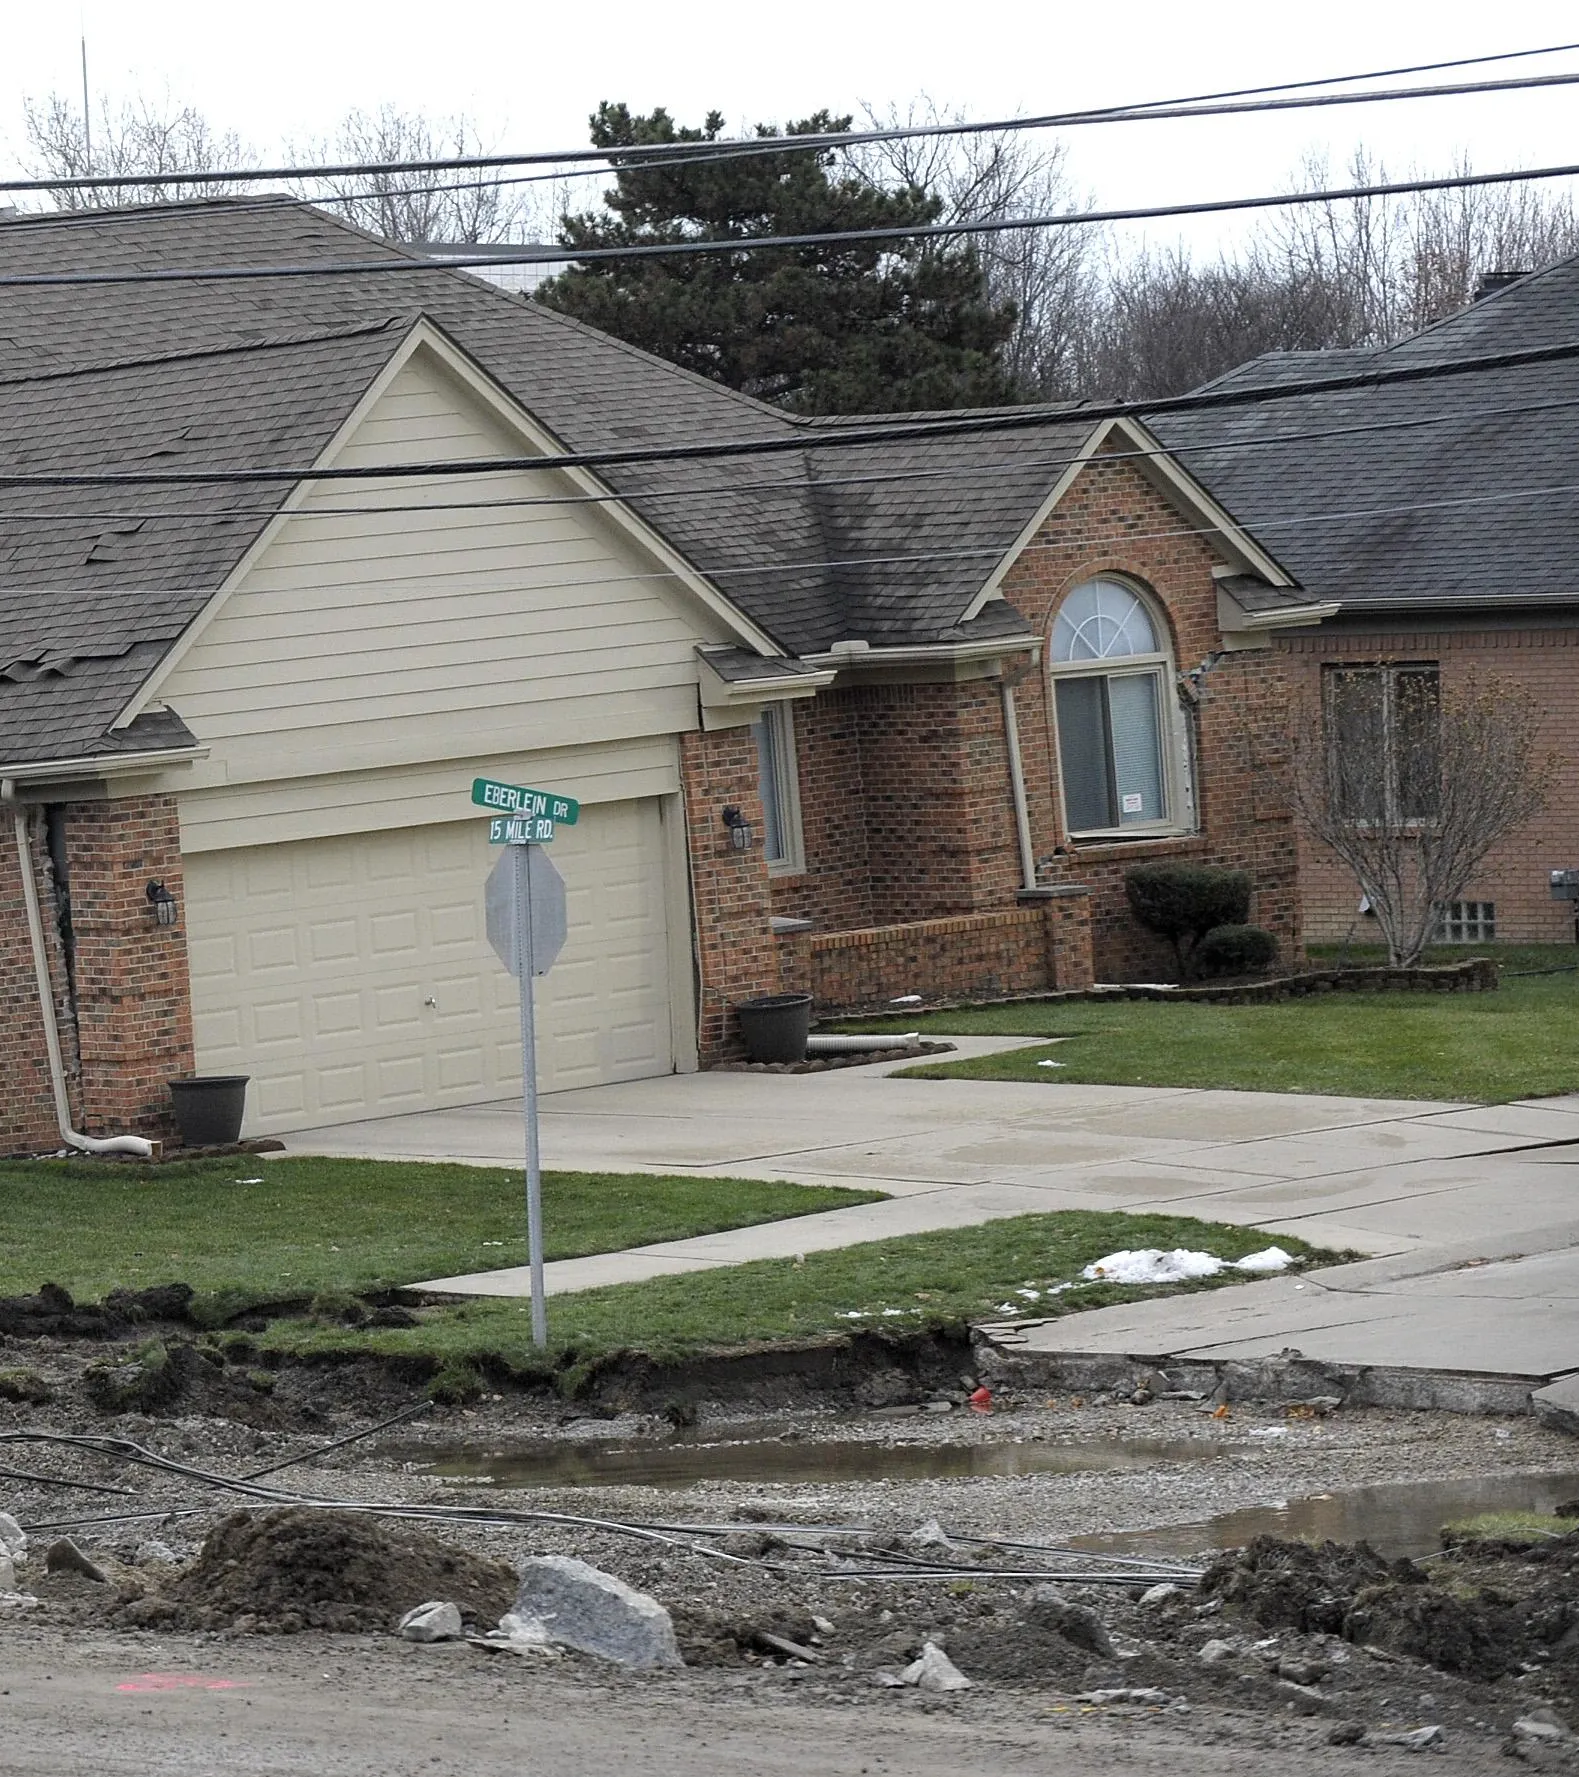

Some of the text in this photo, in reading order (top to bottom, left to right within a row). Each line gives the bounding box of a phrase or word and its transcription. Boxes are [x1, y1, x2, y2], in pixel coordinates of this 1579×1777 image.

[484, 783, 568, 818] EBERLEIN DR
[490, 819, 553, 840] 15 MILE RD.
